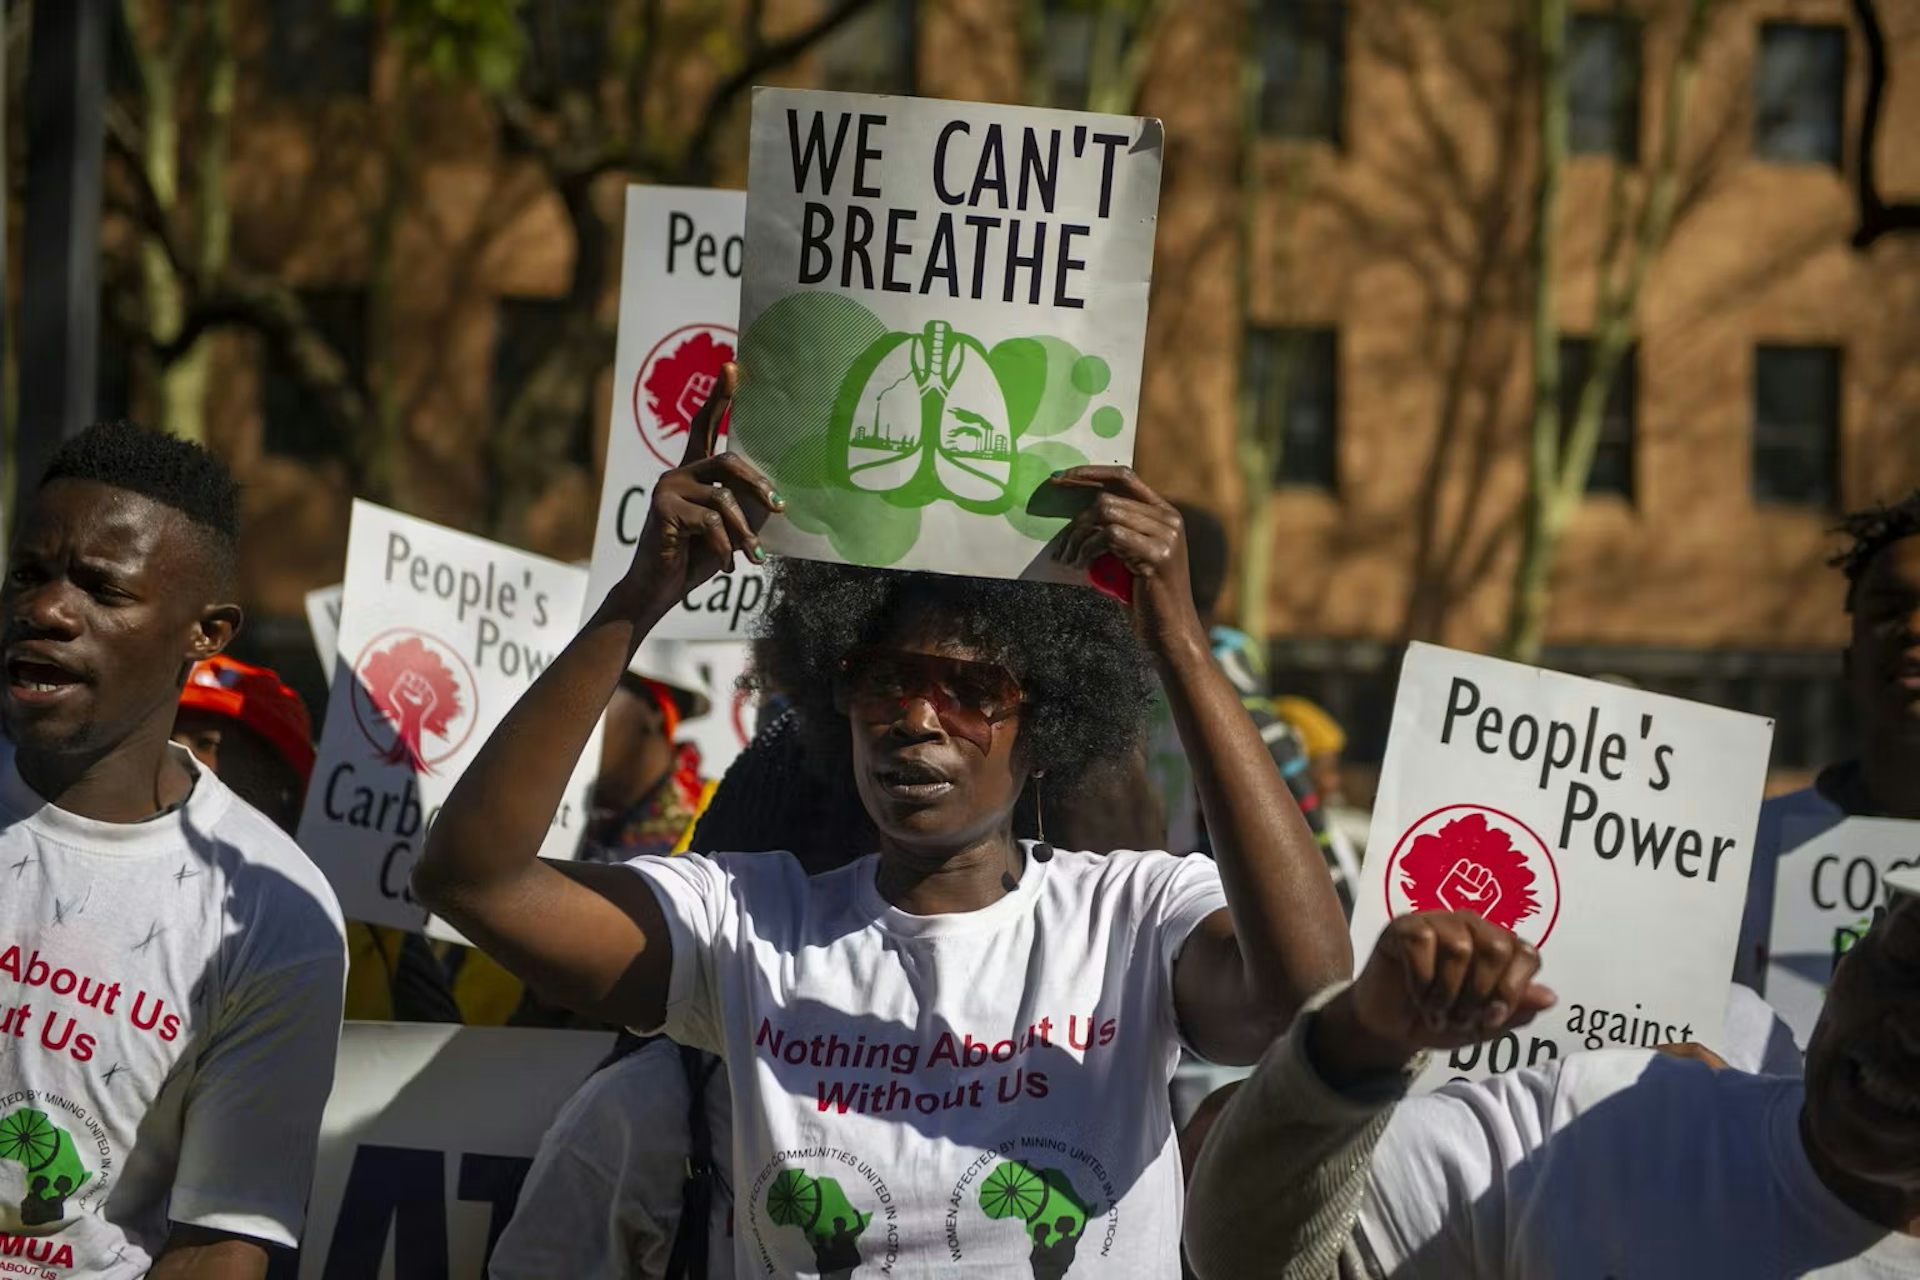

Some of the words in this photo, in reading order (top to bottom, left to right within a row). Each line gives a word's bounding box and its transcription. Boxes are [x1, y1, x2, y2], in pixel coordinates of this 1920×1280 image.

[786, 108, 887, 198] WE
[933, 120, 1129, 218] CAN'T
[798, 202, 1090, 309] BREATHE
[385, 530, 550, 628] People's
[1440, 677, 1674, 791] People's
[324, 762, 441, 838] Carb
[1559, 781, 1736, 882] Power
[0, 945, 122, 1016] About
[130, 991, 181, 1042] Us
[41, 1010, 97, 1062] Us
[755, 1017, 919, 1075] Nothing
[926, 1016, 1053, 1068] About
[1068, 1014, 1115, 1051] Us
[1567, 1003, 1693, 1050] against
[817, 1080, 984, 1115] Without
[998, 1068, 1049, 1103] Us
[27, 1089, 42, 1101] BY
[45, 1093, 86, 1119] MINING
[85, 1117, 112, 1157] UNITED
[101, 1158, 112, 1169] IN
[1000, 1138, 1017, 1154] BY
[1021, 1136, 1067, 1152] MINING
[772, 1147, 858, 1167] COMMUNITIES
[857, 1161, 892, 1206] UNITED
[950, 1148, 998, 1208] AFFECTED
[1069, 1147, 1110, 1183] UNITED
[885, 1205, 898, 1221] IN
[1103, 1180, 1115, 1197] IN
[881, 1222, 899, 1275] ACTION
[945, 1208, 962, 1262] WOMEN
[0, 1261, 39, 1276] ABOUT
